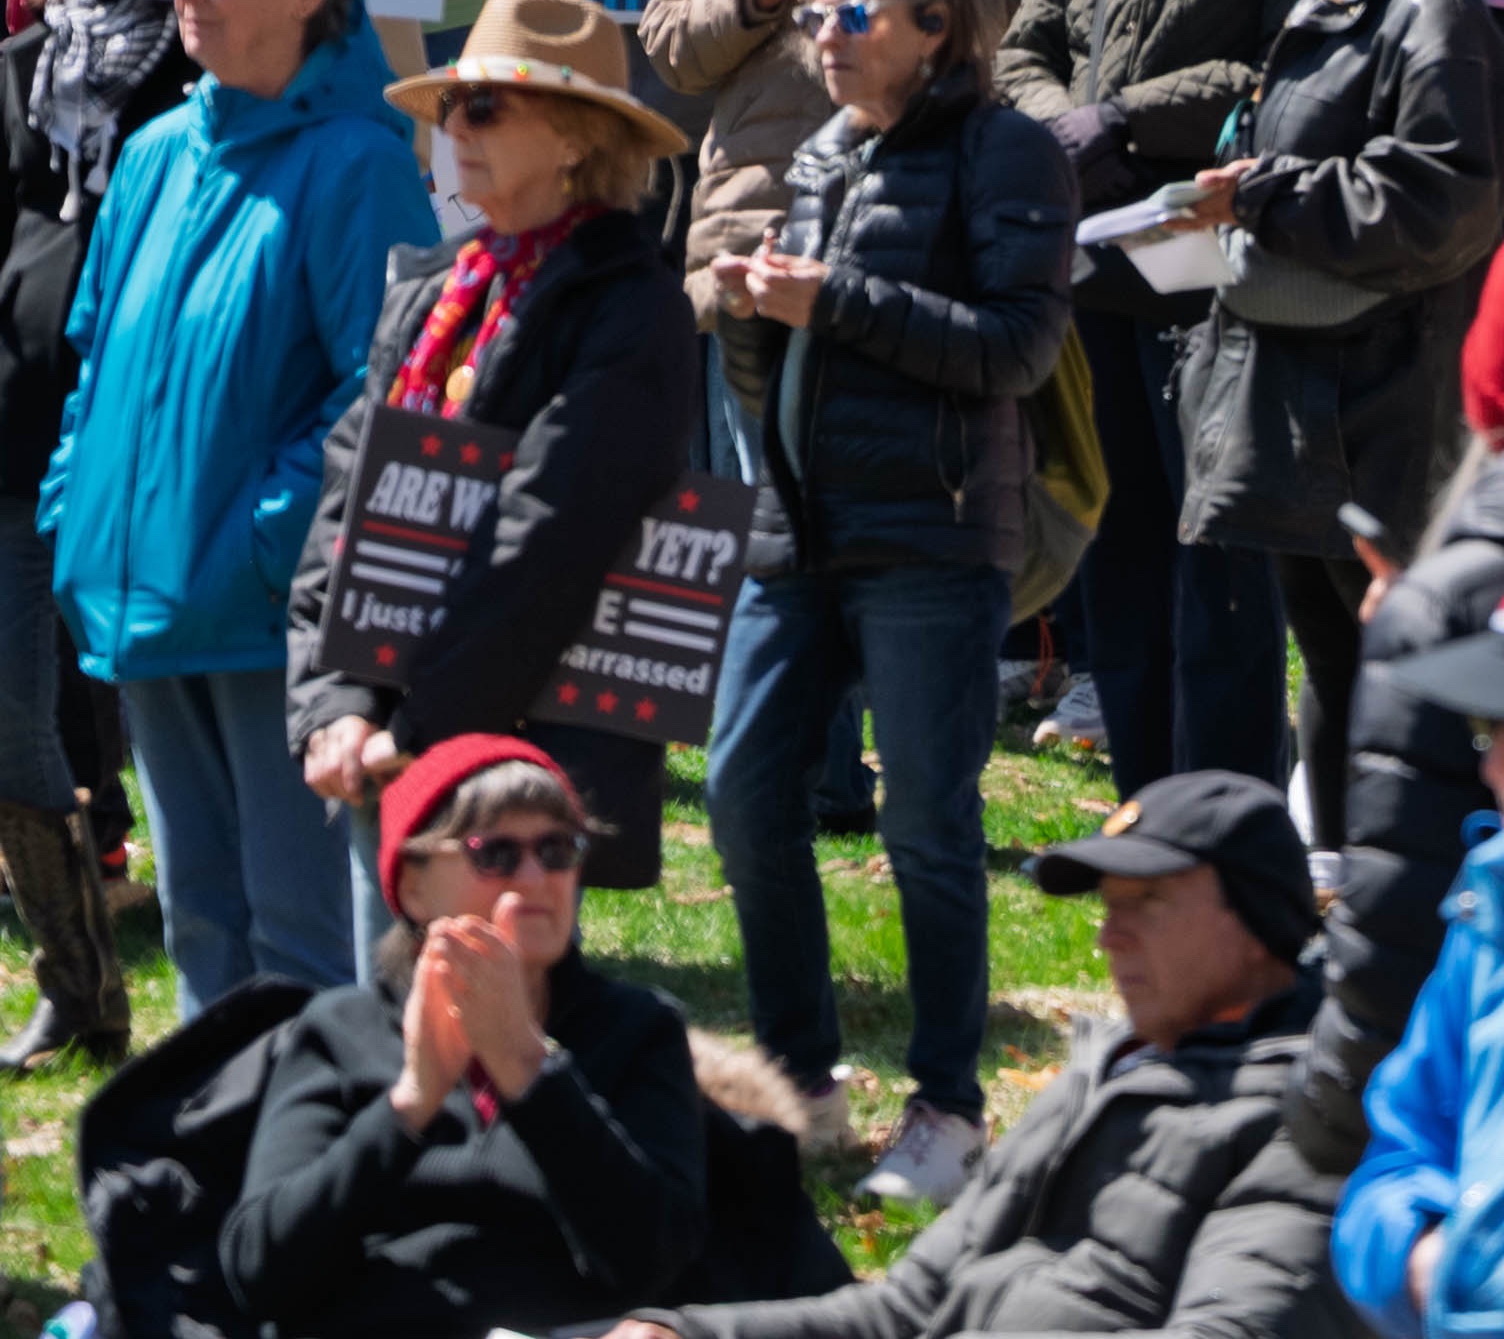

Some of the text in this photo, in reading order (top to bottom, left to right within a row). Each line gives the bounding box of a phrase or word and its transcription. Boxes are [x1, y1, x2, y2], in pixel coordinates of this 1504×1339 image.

[366, 461, 497, 528] ARE W
[635, 516, 739, 587] YET?
[341, 588, 424, 637] I just
[560, 643, 710, 695] arrassed
